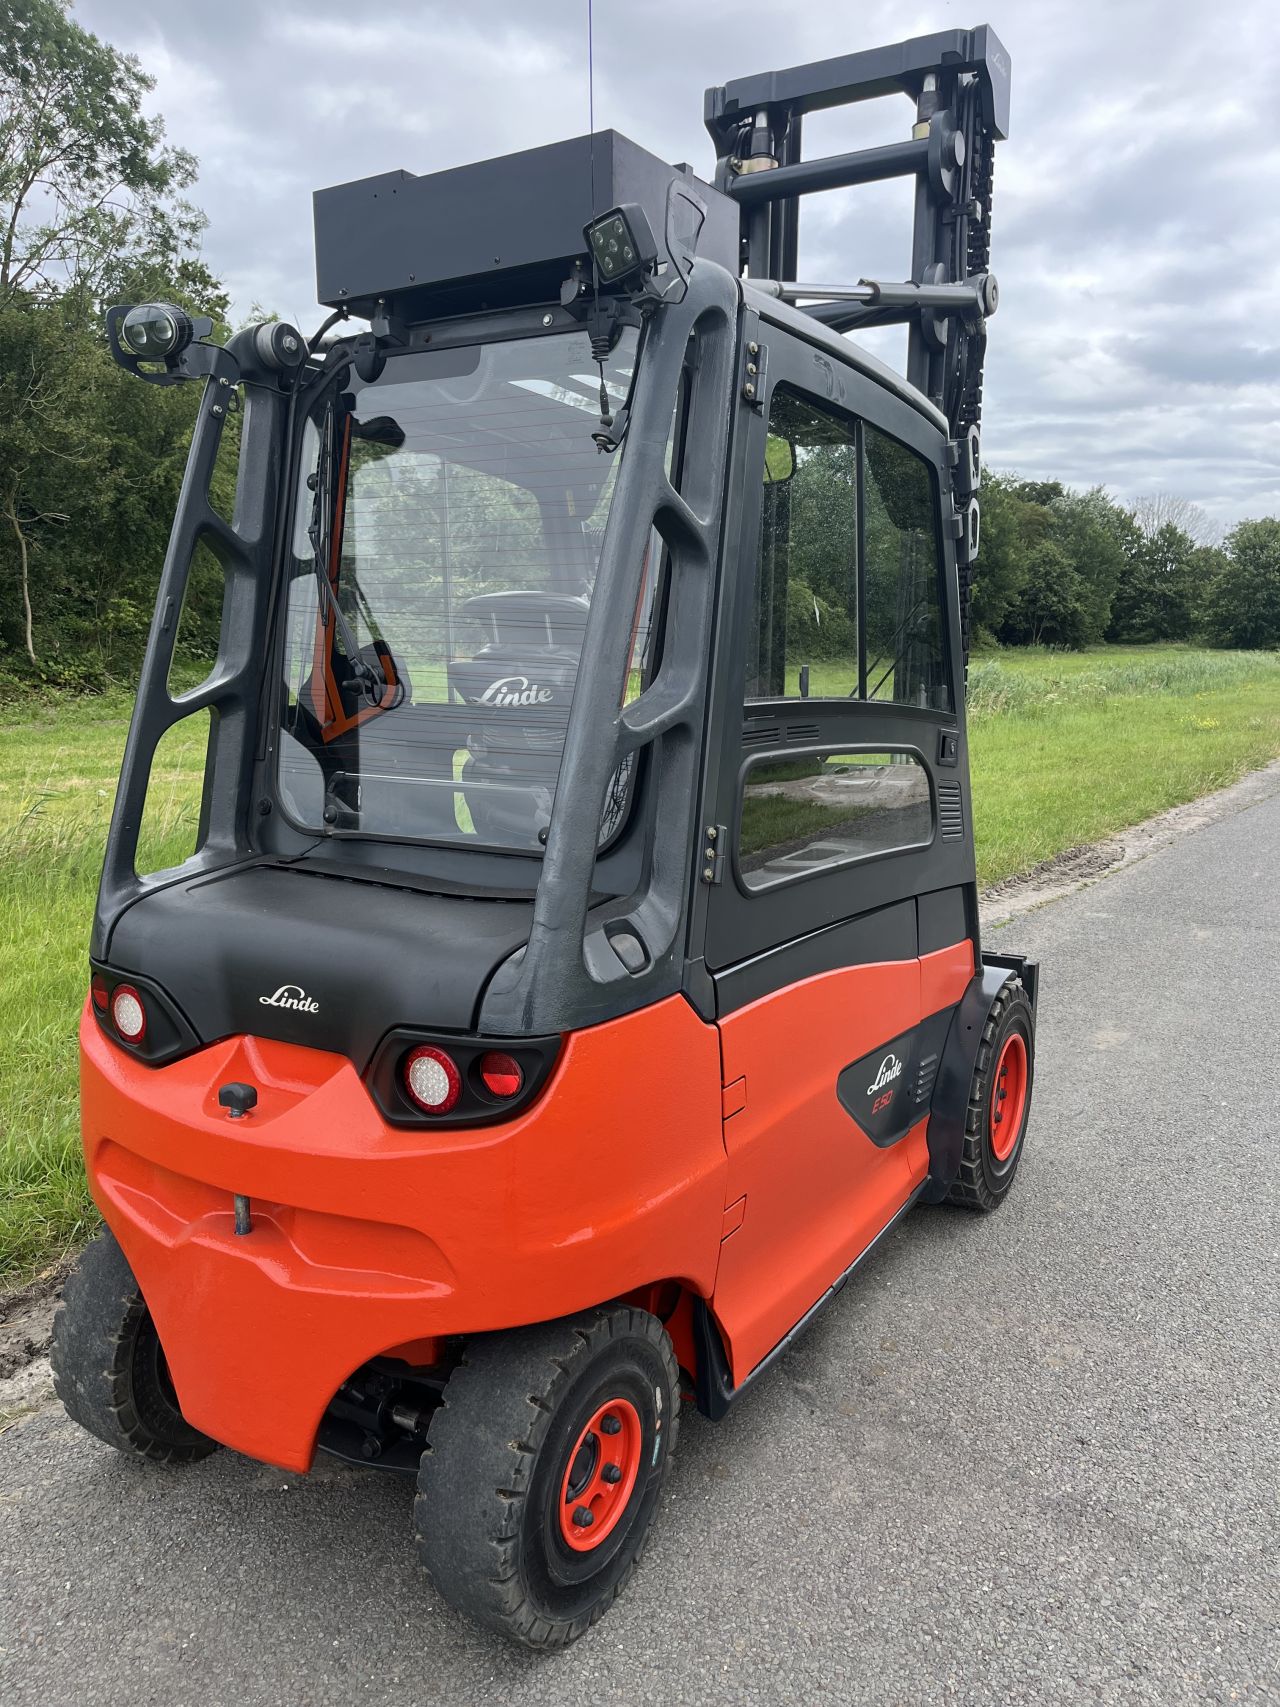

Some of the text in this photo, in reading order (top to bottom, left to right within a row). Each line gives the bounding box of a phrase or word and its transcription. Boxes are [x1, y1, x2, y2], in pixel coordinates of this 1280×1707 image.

[468, 676, 553, 706] Linde
[259, 985, 319, 1013] Linde
[866, 1054, 902, 1095] Linde
